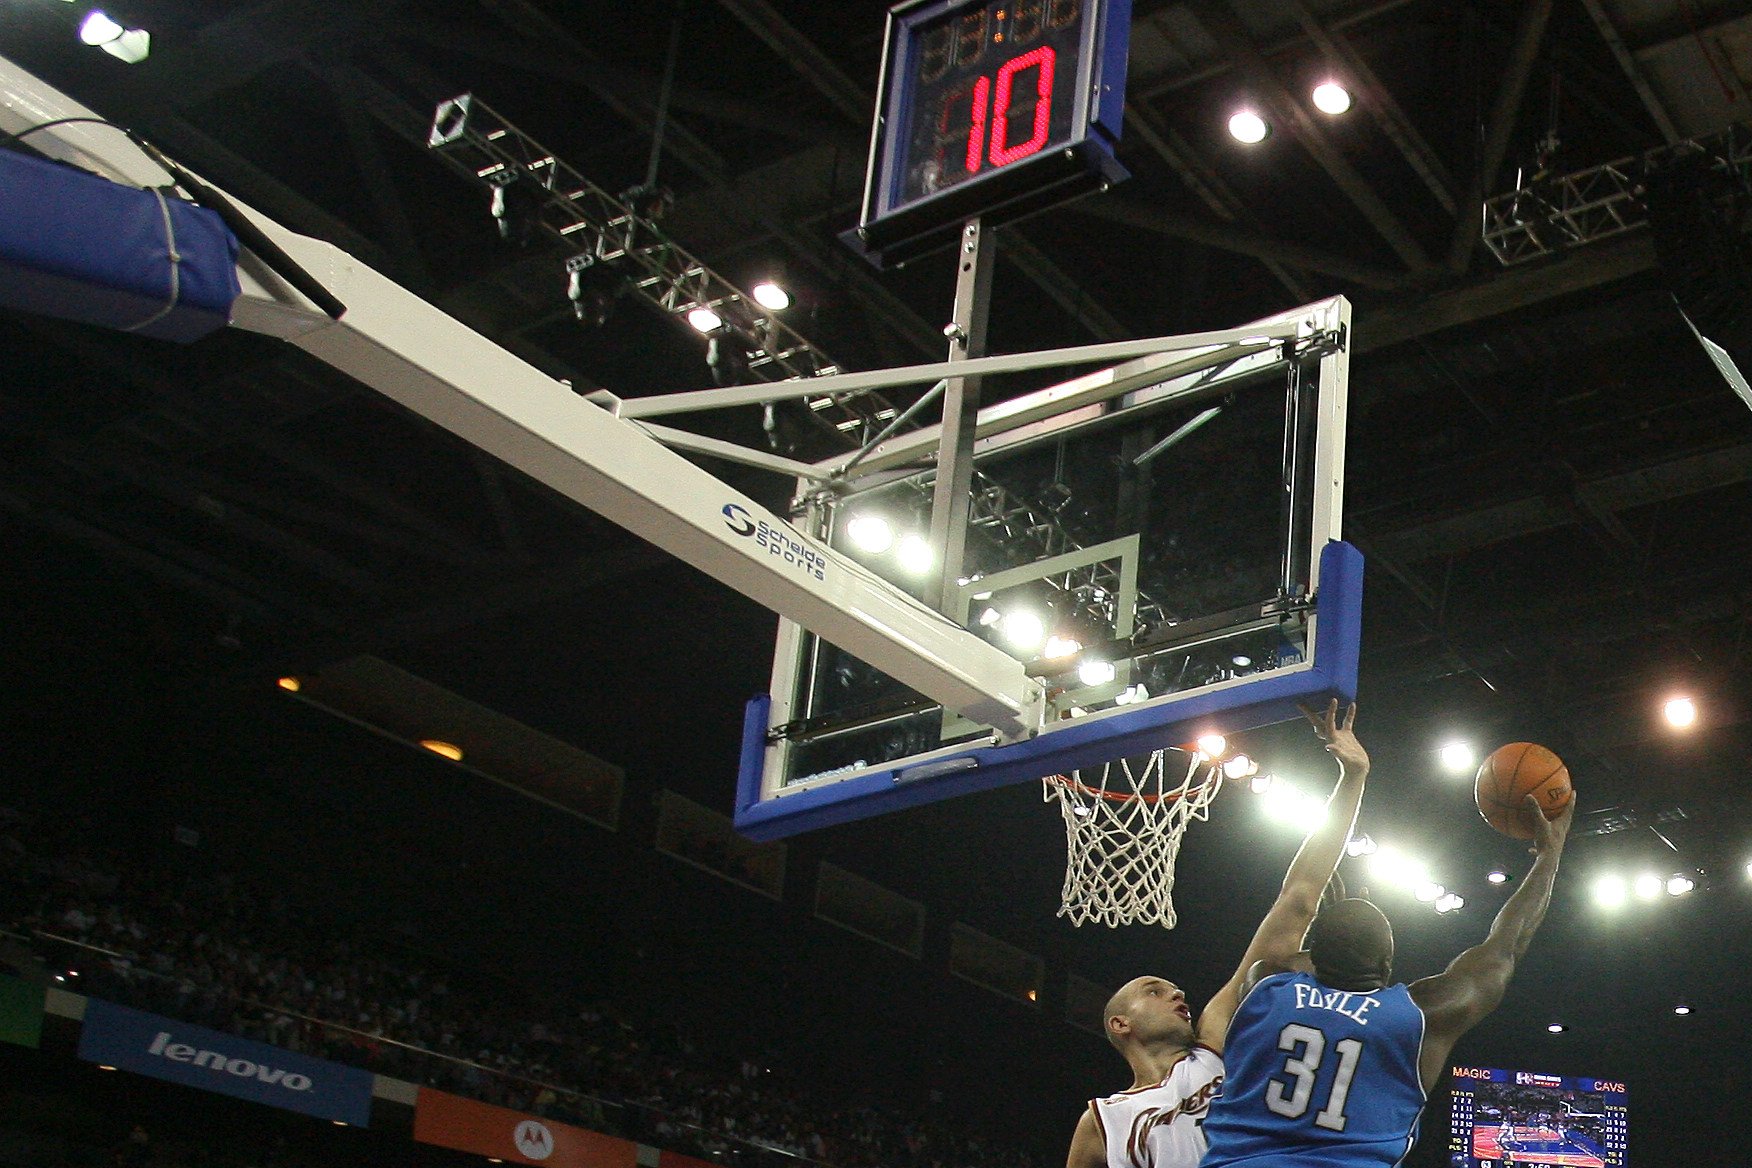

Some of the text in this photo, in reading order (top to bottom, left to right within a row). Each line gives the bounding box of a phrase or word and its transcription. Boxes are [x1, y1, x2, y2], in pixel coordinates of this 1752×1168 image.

[965, 45, 1056, 173] 10
[756, 533, 824, 581] Sports
[757, 520, 826, 569] Schelde
[1294, 983, 1381, 1026] FOYLE
[148, 1032, 312, 1091] lenovo
[1265, 1023, 1363, 1132] 31
[1452, 1066, 1491, 1080] MAGIC
[1594, 1081, 1625, 1093] CAVS
